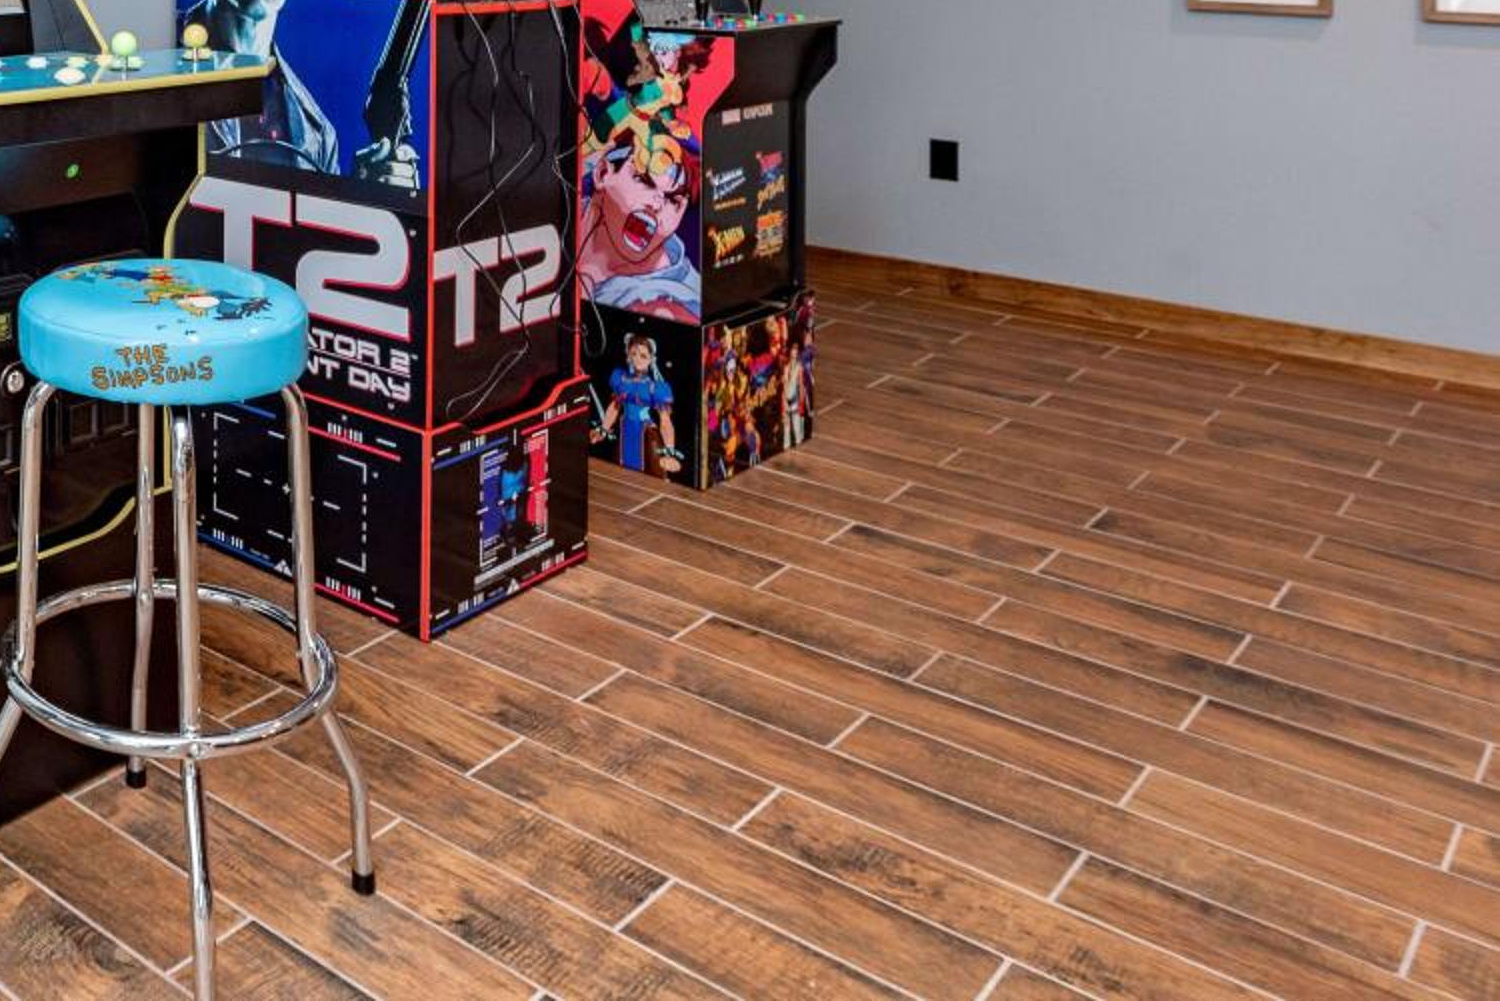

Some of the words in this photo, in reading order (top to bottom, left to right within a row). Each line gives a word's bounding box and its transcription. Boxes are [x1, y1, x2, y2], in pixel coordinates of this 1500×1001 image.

[190, 176, 411, 341] T2
[433, 224, 561, 348] T2
[91, 355, 213, 390] SIMPSONS
[116, 343, 170, 367] THE
[390, 348, 411, 375] 2
[348, 365, 411, 402] DAY
